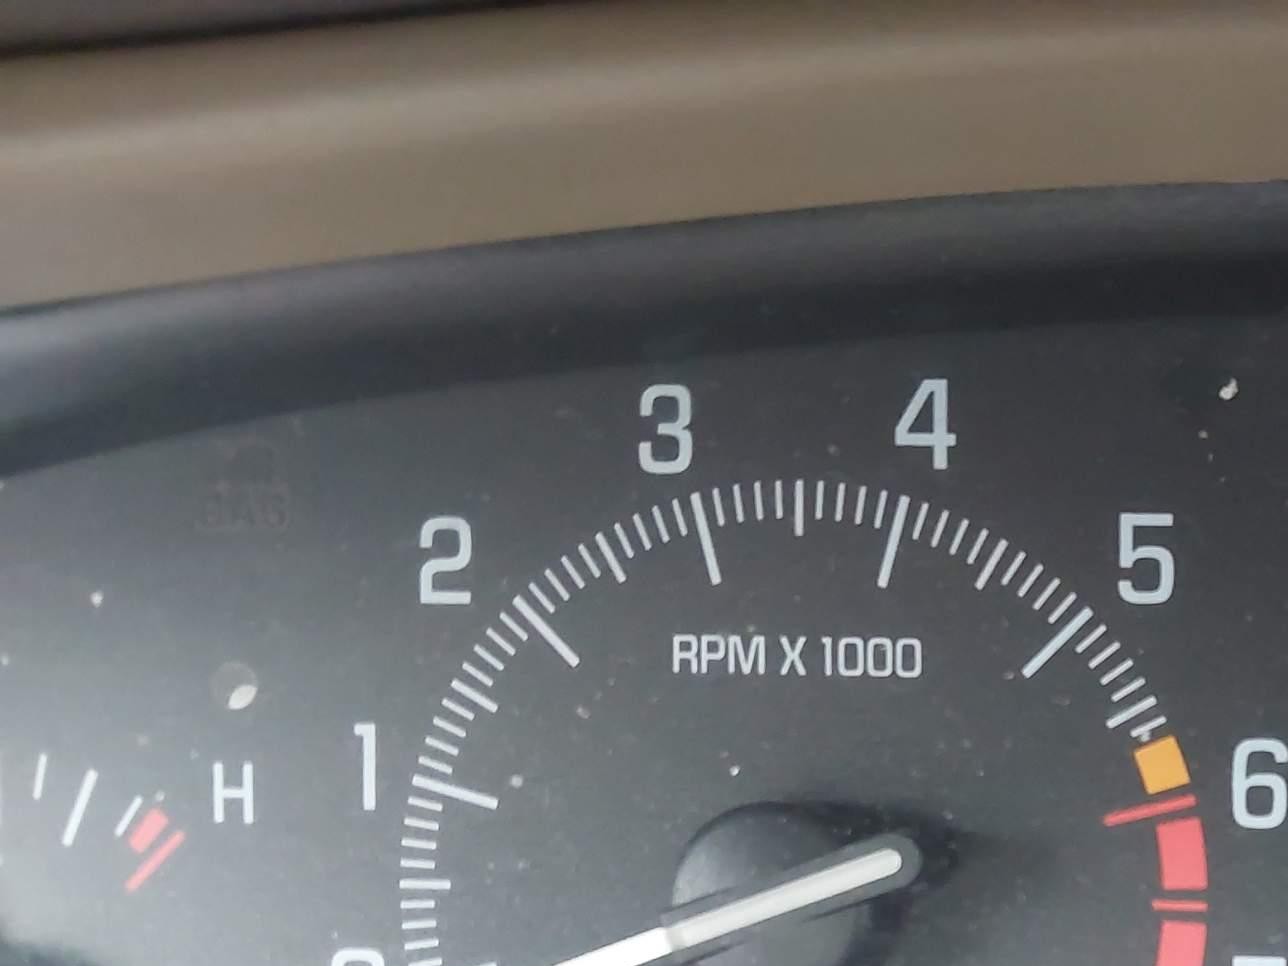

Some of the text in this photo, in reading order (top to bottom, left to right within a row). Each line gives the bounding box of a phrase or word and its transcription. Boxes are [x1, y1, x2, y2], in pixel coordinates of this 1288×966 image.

[638, 384, 693, 475] 3
[894, 378, 957, 470] 4
[419, 516, 472, 605] 2
[1117, 512, 1175, 605] 5
[672, 634, 922, 678] RPM X 1000
[212, 762, 254, 825] H
[353, 723, 376, 811] 1
[1231, 738, 1288, 830] 6
